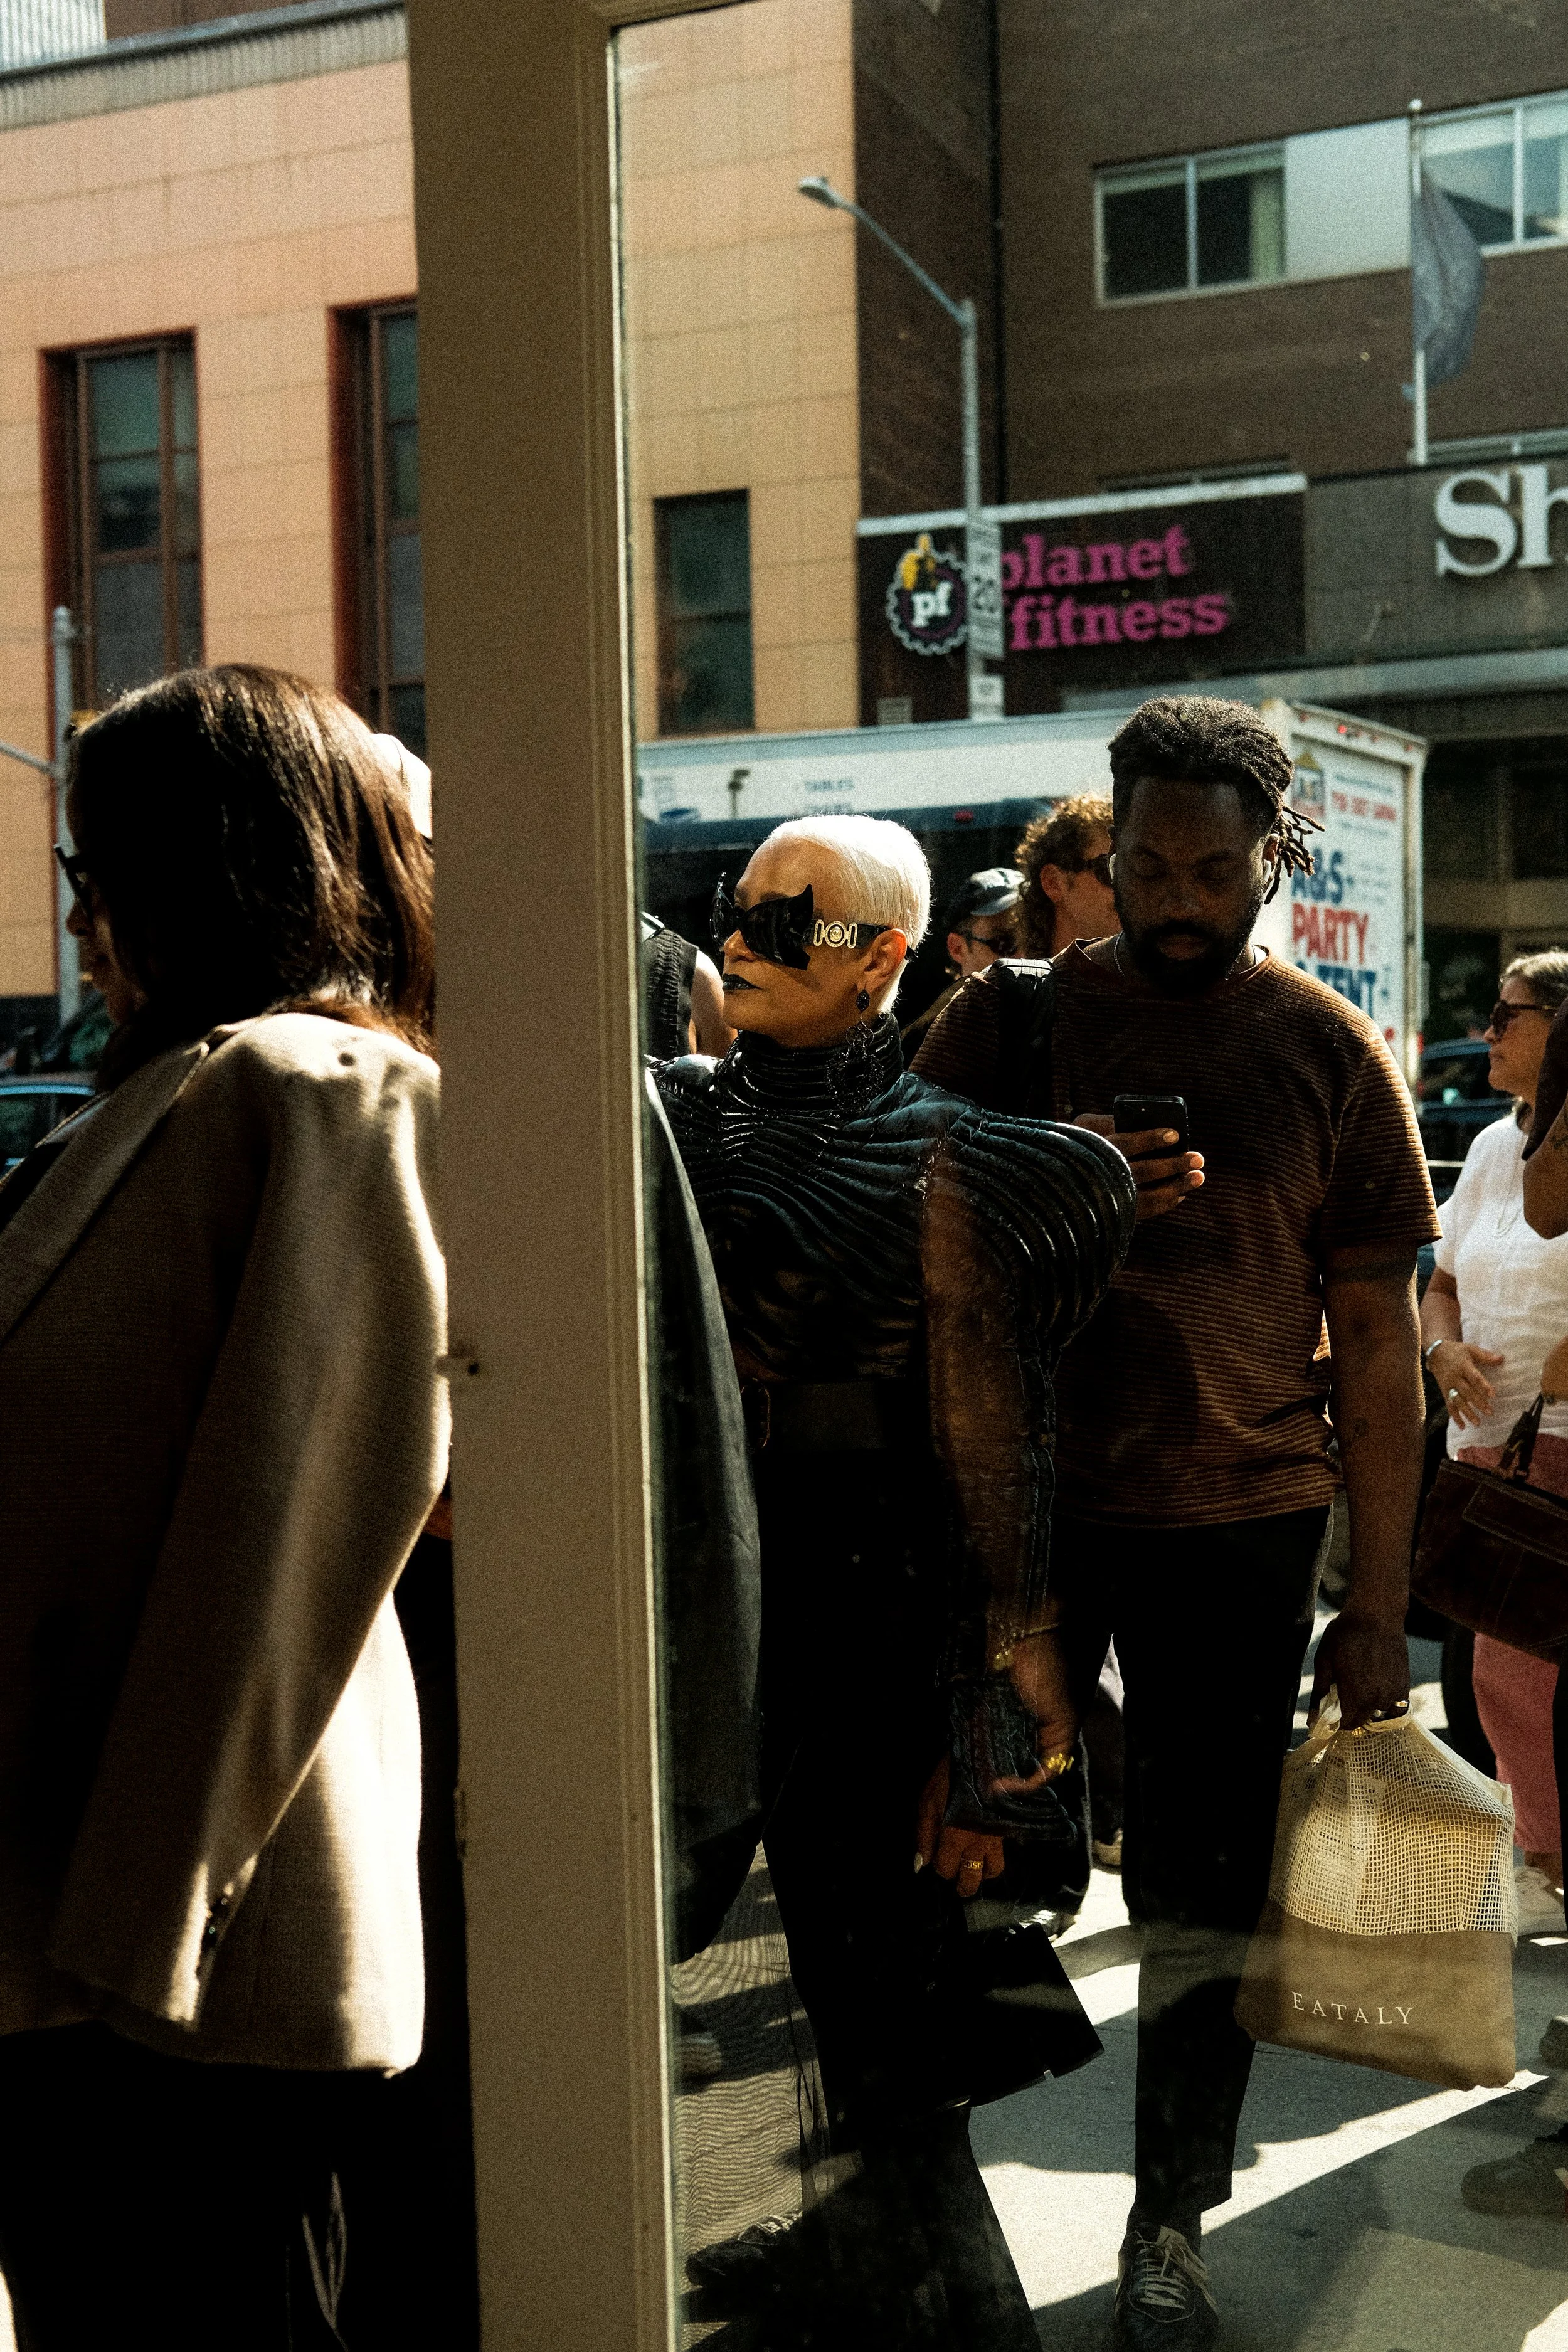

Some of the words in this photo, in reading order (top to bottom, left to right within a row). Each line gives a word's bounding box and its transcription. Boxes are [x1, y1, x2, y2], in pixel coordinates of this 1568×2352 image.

[911, 581, 953, 628] pf
[1009, 593, 1231, 650] fitness
[1291, 902, 1369, 964] PARTY
[1292, 1991, 1413, 2025] EATALY
